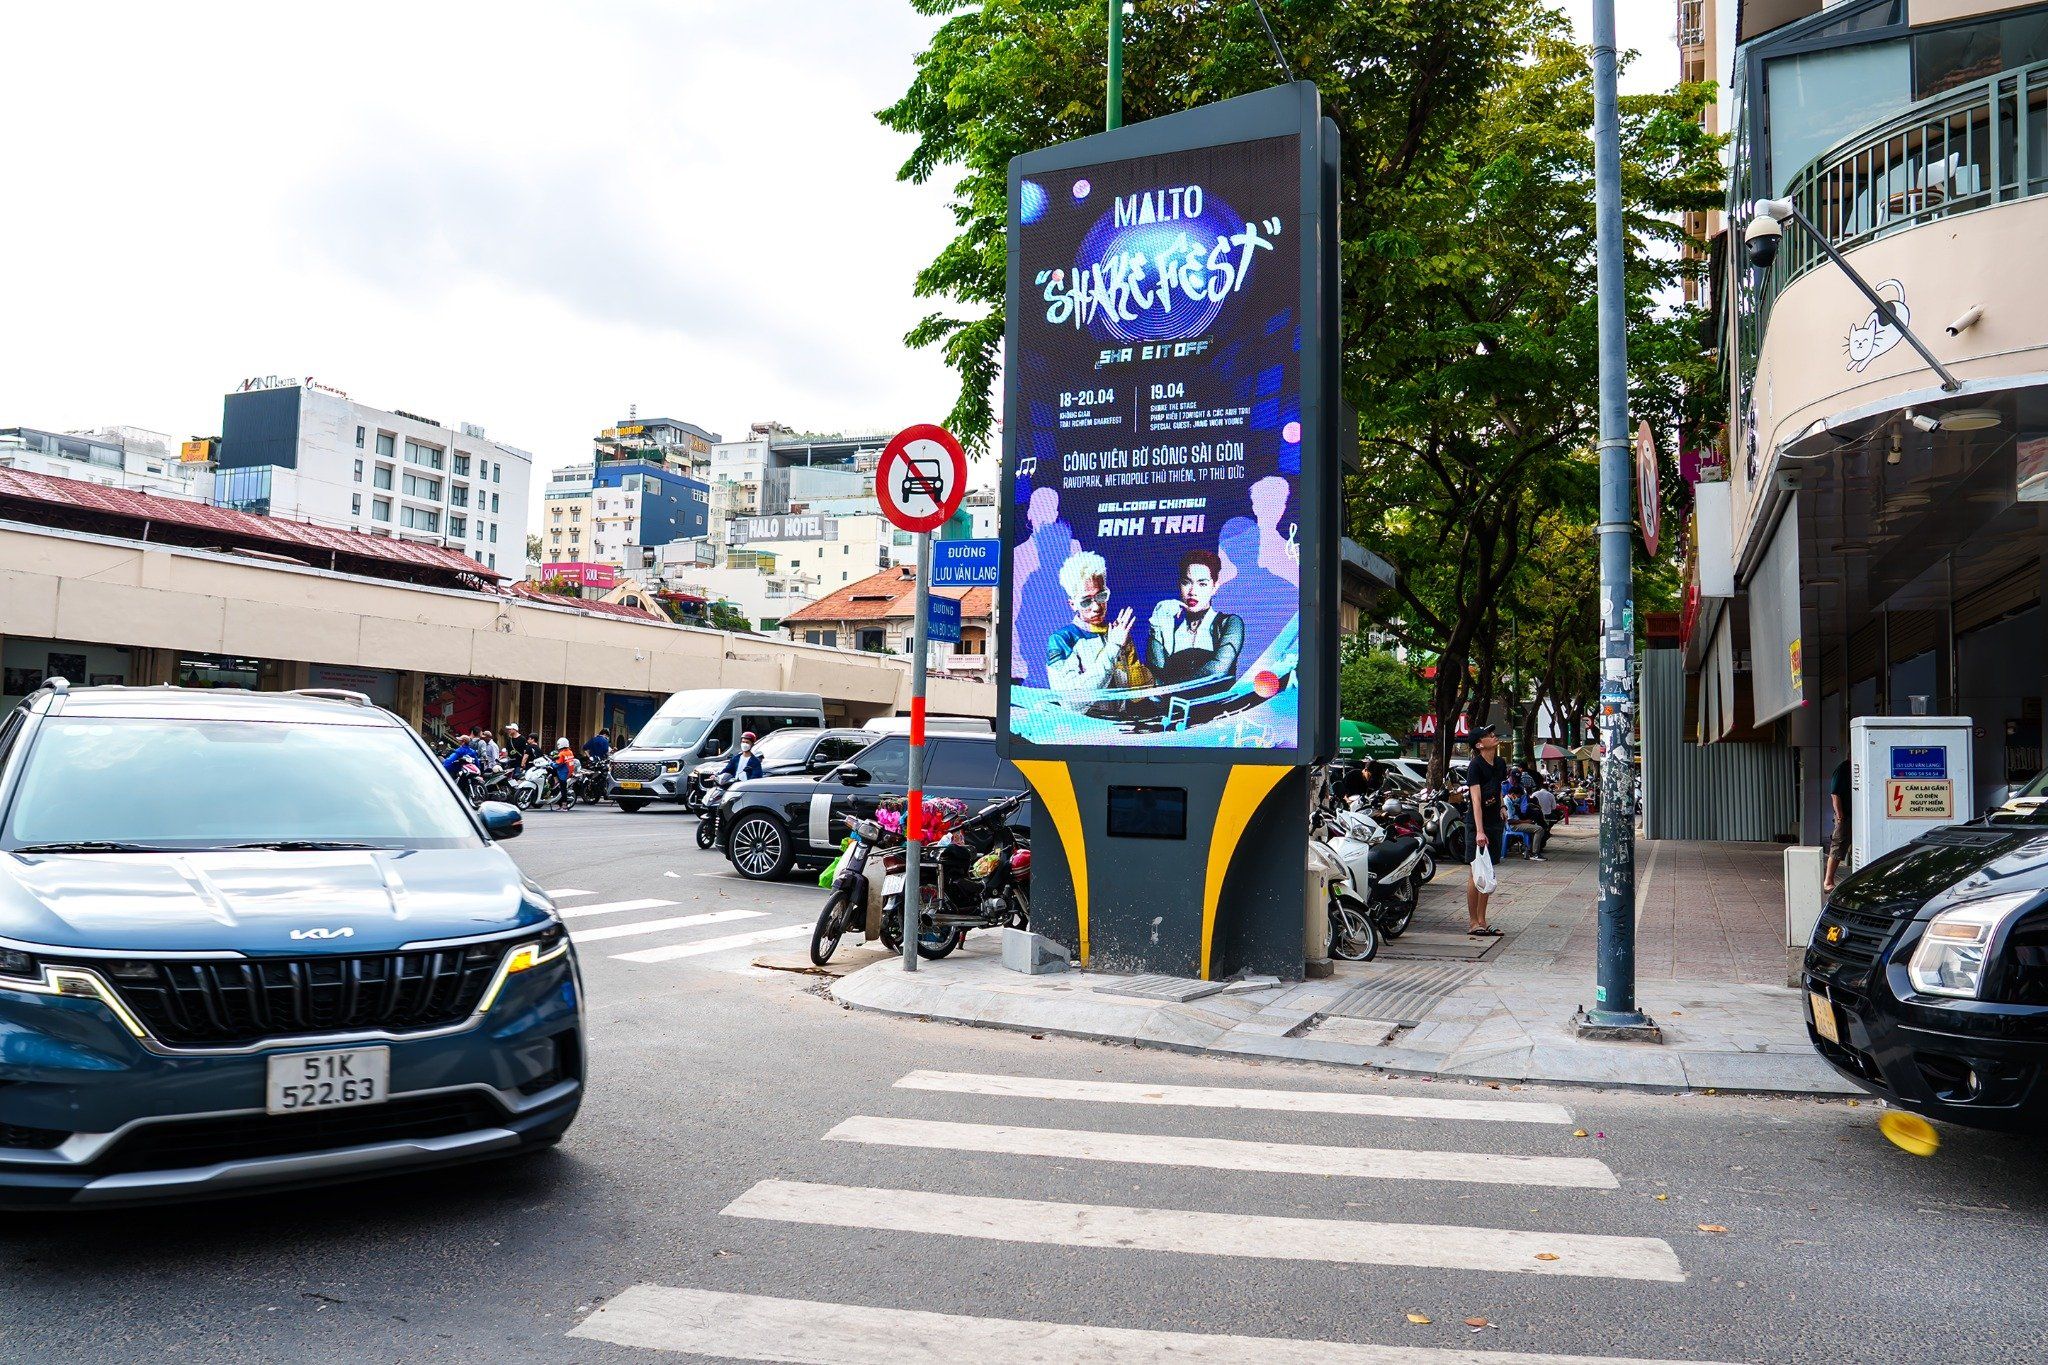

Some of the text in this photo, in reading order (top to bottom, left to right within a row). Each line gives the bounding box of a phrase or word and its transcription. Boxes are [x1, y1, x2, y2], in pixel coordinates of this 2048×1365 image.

[1114, 185, 1203, 228] MALTO
[1174, 341, 1209, 357] OFF
[1060, 388, 1114, 408] 18-20.04
[1150, 382, 1185, 400] 19.04
[1179, 402, 1197, 410] STAGE
[1150, 422, 1171, 431] SPECIAL
[1063, 451, 1097, 472] CÔNG
[1099, 448, 1128, 469] VIÊN
[1152, 445, 1187, 465] SÔNG
[1191, 441, 1211, 463] SÀI
[1217, 440, 1244, 461] GÒN
[1104, 472, 1149, 486] METROPOLE
[1198, 468, 1208, 481] TP
[1097, 500, 1157, 513] WELCOME
[749, 517, 822, 538] HALO HOTEL
[1097, 514, 1206, 537] ANH TRAI
[947, 546, 986, 558] ĐƯỜNG
[935, 563, 997, 581] LƯU VĂN LANG
[290, 926, 355, 940] KIA
[304, 1053, 354, 1081] 51K
[281, 1076, 375, 1110] 522.63
